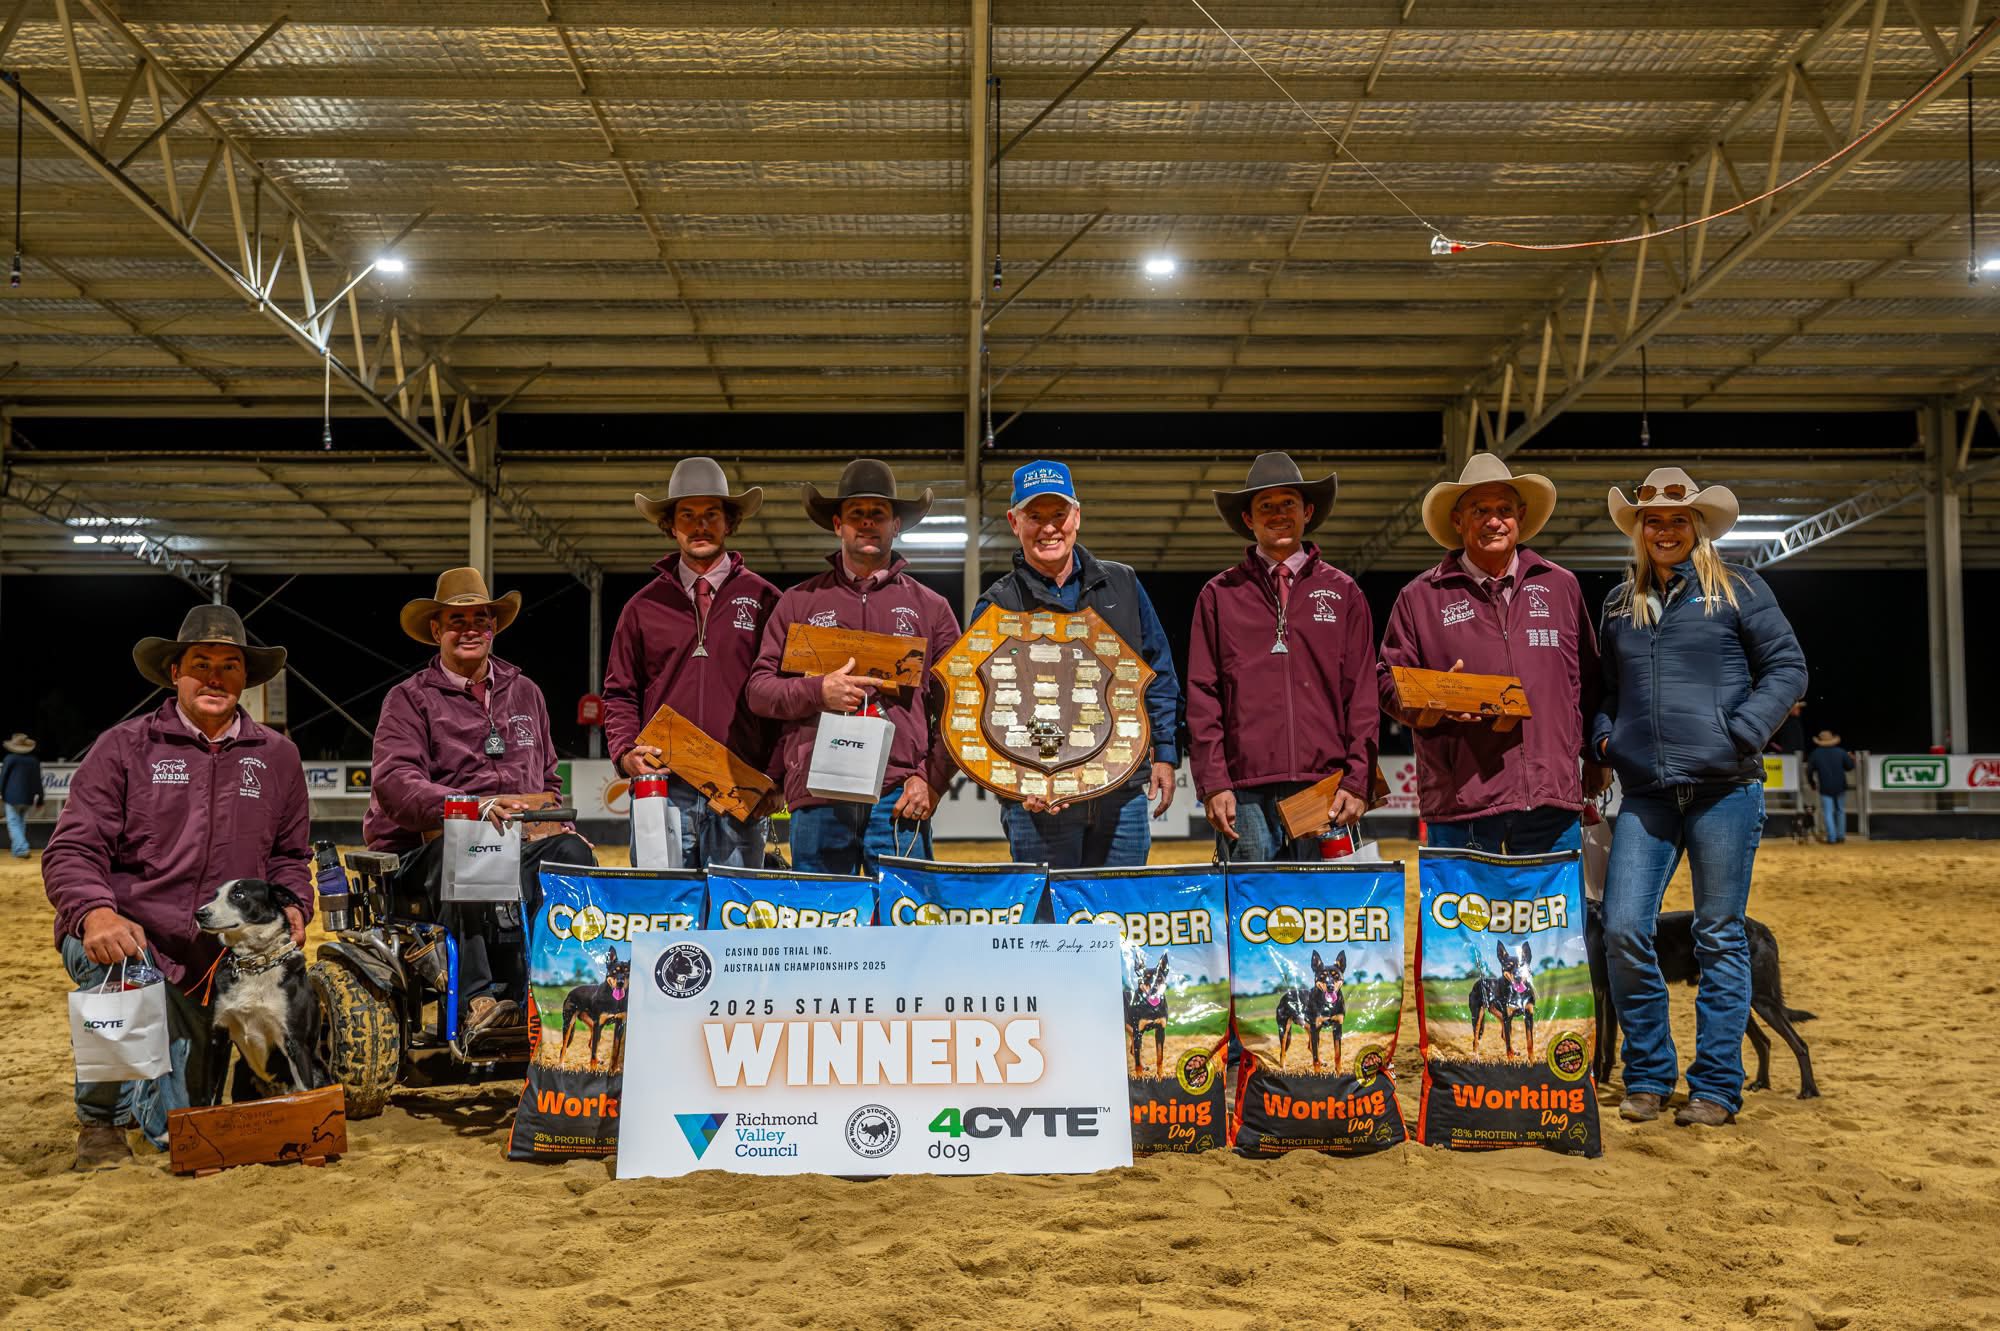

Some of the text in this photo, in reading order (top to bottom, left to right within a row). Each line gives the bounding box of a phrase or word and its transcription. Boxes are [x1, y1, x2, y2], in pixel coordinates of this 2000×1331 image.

[831, 738, 864, 749] 4CYTE
[152, 773, 189, 781] AWSDM
[468, 845, 502, 853] 4CYTE
[1432, 892, 1568, 934] COBBER
[1240, 905, 1390, 945] COBBER
[669, 945, 701, 954] CASINO
[992, 938, 1024, 949] DATE
[1057, 938, 1084, 953] July
[1089, 940, 1115, 949] 2025
[725, 946, 832, 957] CASINO DOG TRIAL INC.
[723, 961, 886, 973] AUSTRALIAN CHAMPIONSHIPS 2025
[662, 985, 704, 997] DOG TRIAL
[709, 996, 1038, 1016] 2025 STATE OF ORIGIN
[84, 1020, 124, 1029] 4CYTE
[703, 1018, 1045, 1087] WINNERS
[537, 1088, 619, 1118] Work
[1263, 1090, 1386, 1120] Working
[1452, 1083, 1585, 1114] Working
[735, 1112, 819, 1126] Richmond
[1131, 1098, 1212, 1126] rking
[849, 1110, 866, 1137] WORKING
[866, 1108, 888, 1118] STOCK
[1348, 1118, 1375, 1136] Dog
[1541, 1110, 1569, 1131] Dog
[534, 1132, 618, 1145] 28% PROTEIN 18
[735, 1128, 786, 1144] Valley
[1168, 1124, 1196, 1144] Dog
[1259, 1134, 1369, 1146] 28% PROTEIN 18% FAT
[1451, 1128, 1562, 1140] 28% PROTEIN 18% FAT
[735, 1143, 798, 1157] Council
[928, 1140, 970, 1162] dog
[1173, 1143, 1190, 1152] FAT
